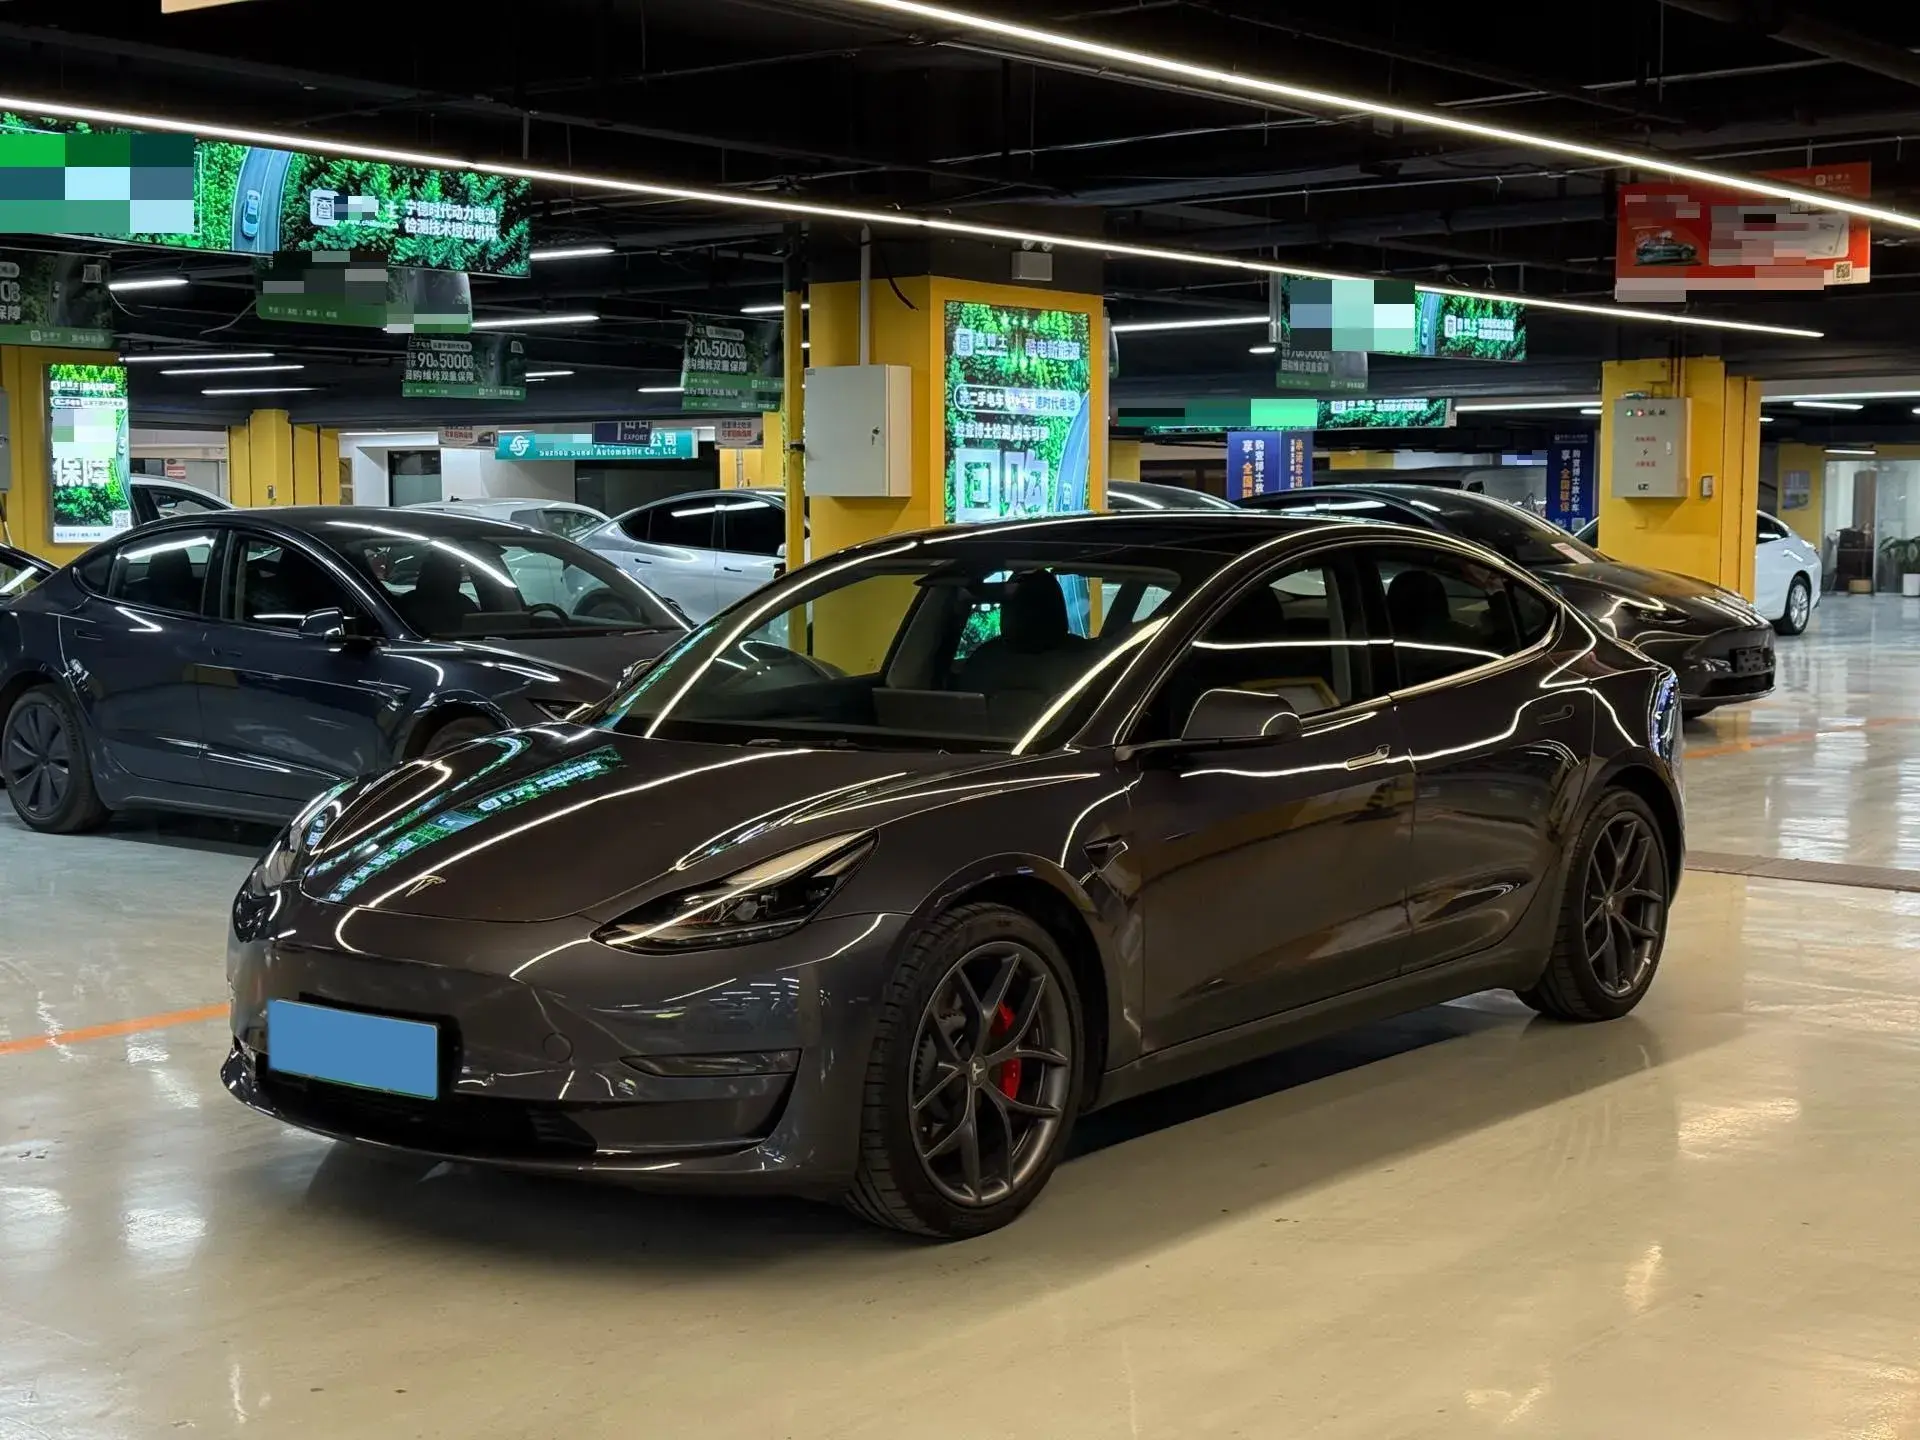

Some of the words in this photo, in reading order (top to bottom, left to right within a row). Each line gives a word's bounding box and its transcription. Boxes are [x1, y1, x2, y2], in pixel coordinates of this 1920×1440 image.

[405, 199, 497, 223] 宁德时代动力电池
[623, 433, 648, 441] EXPORT
[596, 447, 642, 456] Automobile
[53, 457, 109, 488] 保障
[955, 447, 1049, 524] 回购
